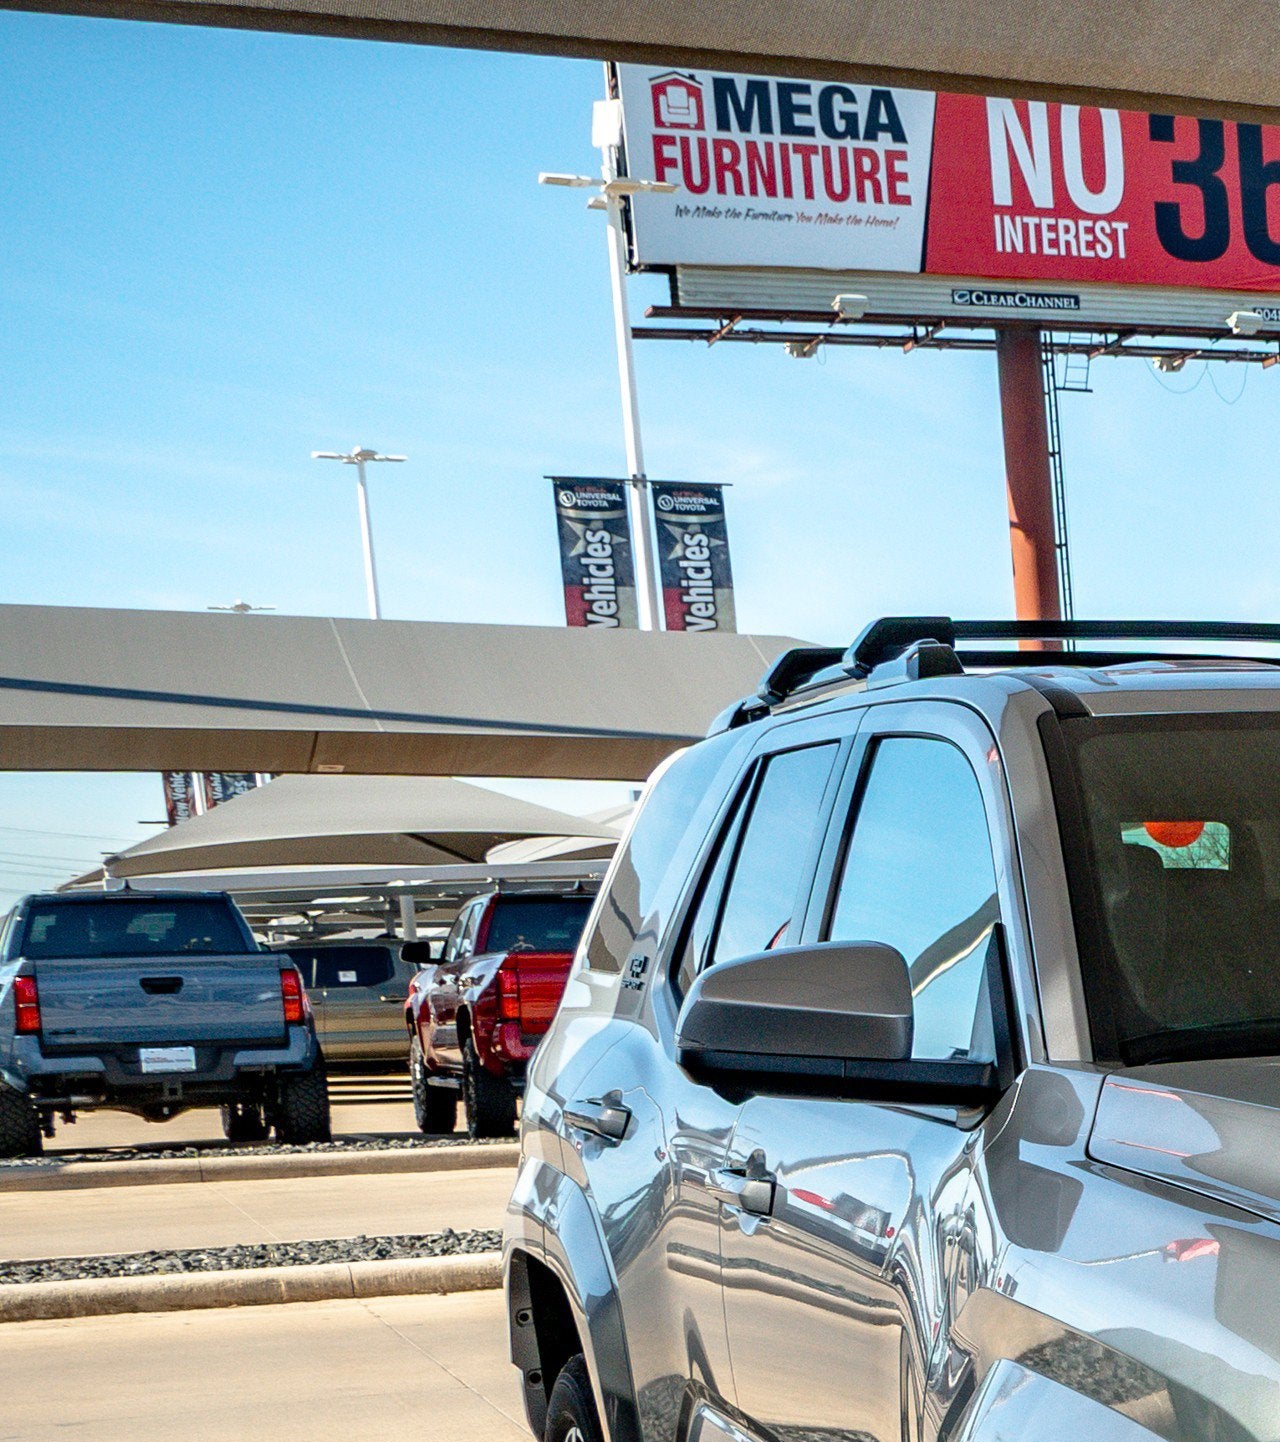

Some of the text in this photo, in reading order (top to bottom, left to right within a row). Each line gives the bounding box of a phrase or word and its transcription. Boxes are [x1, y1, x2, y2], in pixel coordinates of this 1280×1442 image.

[711, 76, 909, 145] MEGA
[651, 134, 912, 206] FURNITURE
[985, 97, 1125, 215] NO
[744, 208, 793, 222] Furniture
[993, 214, 1129, 259] INTEREST
[575, 492, 622, 502] UNIVERSAL
[576, 500, 609, 508] TOYOTA
[673, 496, 720, 506] UNIVERSAL
[674, 504, 706, 512] TOYOTA
[580, 529, 619, 629] Vehicles
[678, 533, 717, 633] Vehicles
